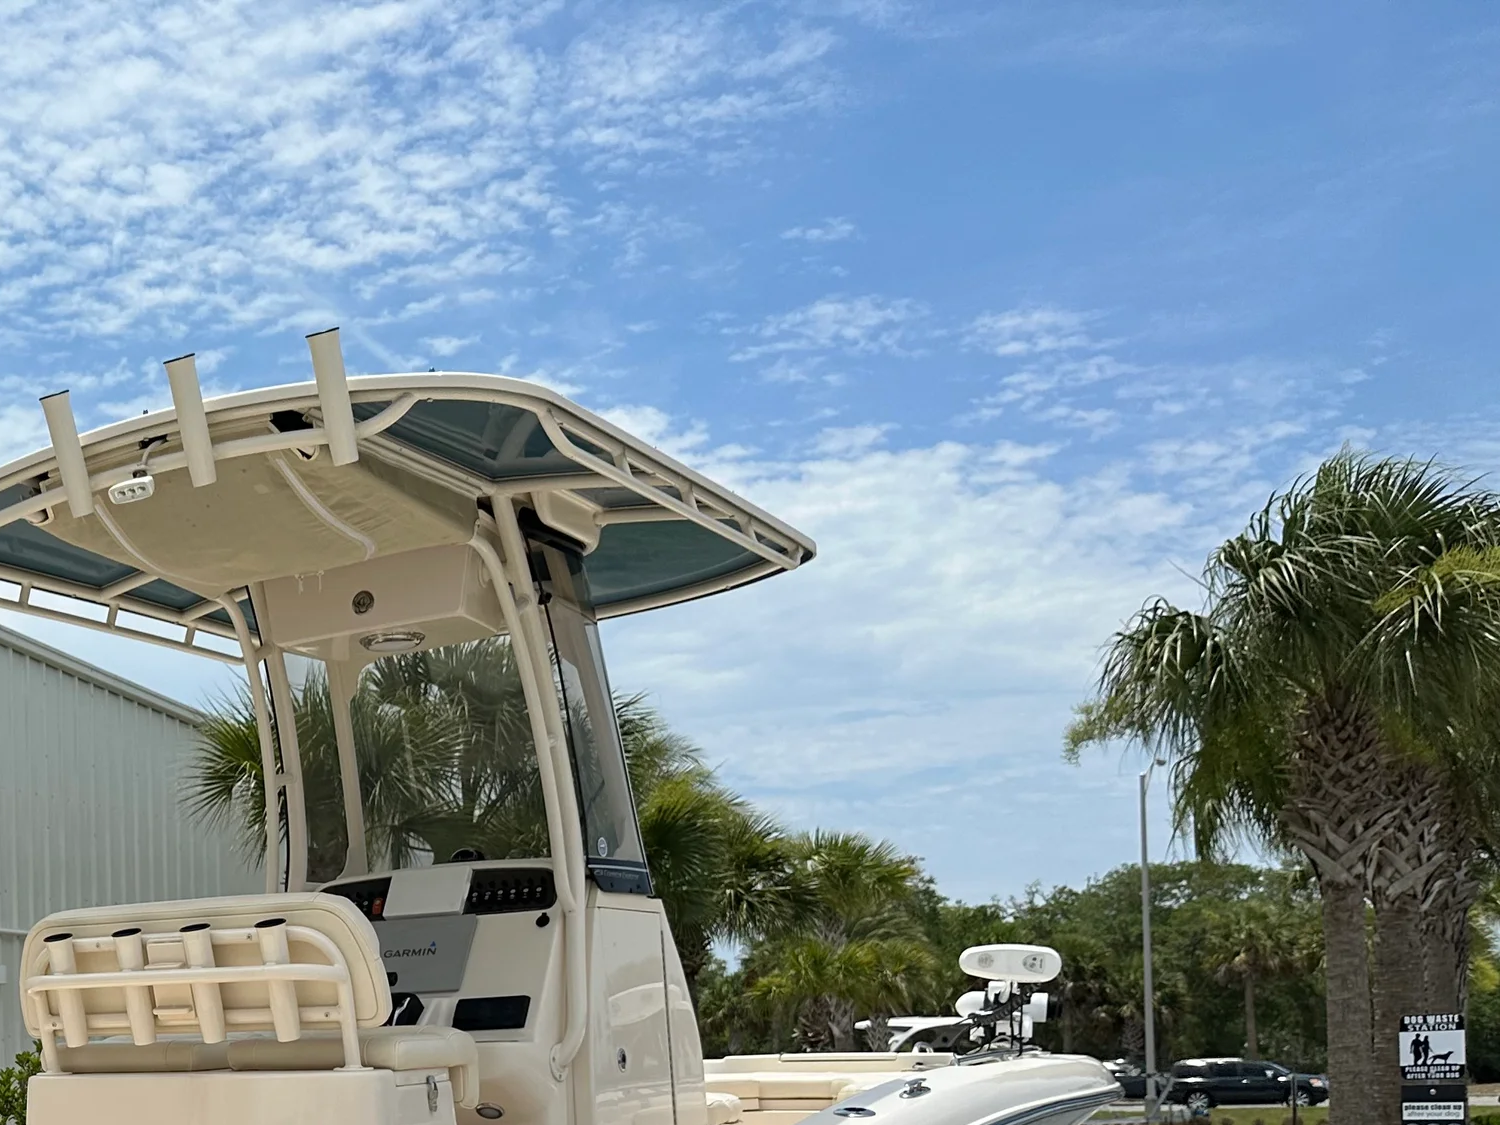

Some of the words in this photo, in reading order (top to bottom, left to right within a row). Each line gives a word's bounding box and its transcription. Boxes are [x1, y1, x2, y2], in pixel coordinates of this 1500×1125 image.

[382, 947, 437, 959] GARMIN
[1404, 1015, 1424, 1024] DOG
[1426, 1014, 1459, 1024] WASTE
[1407, 1023, 1457, 1032] STATION
[1444, 1110, 1461, 1118] dog
